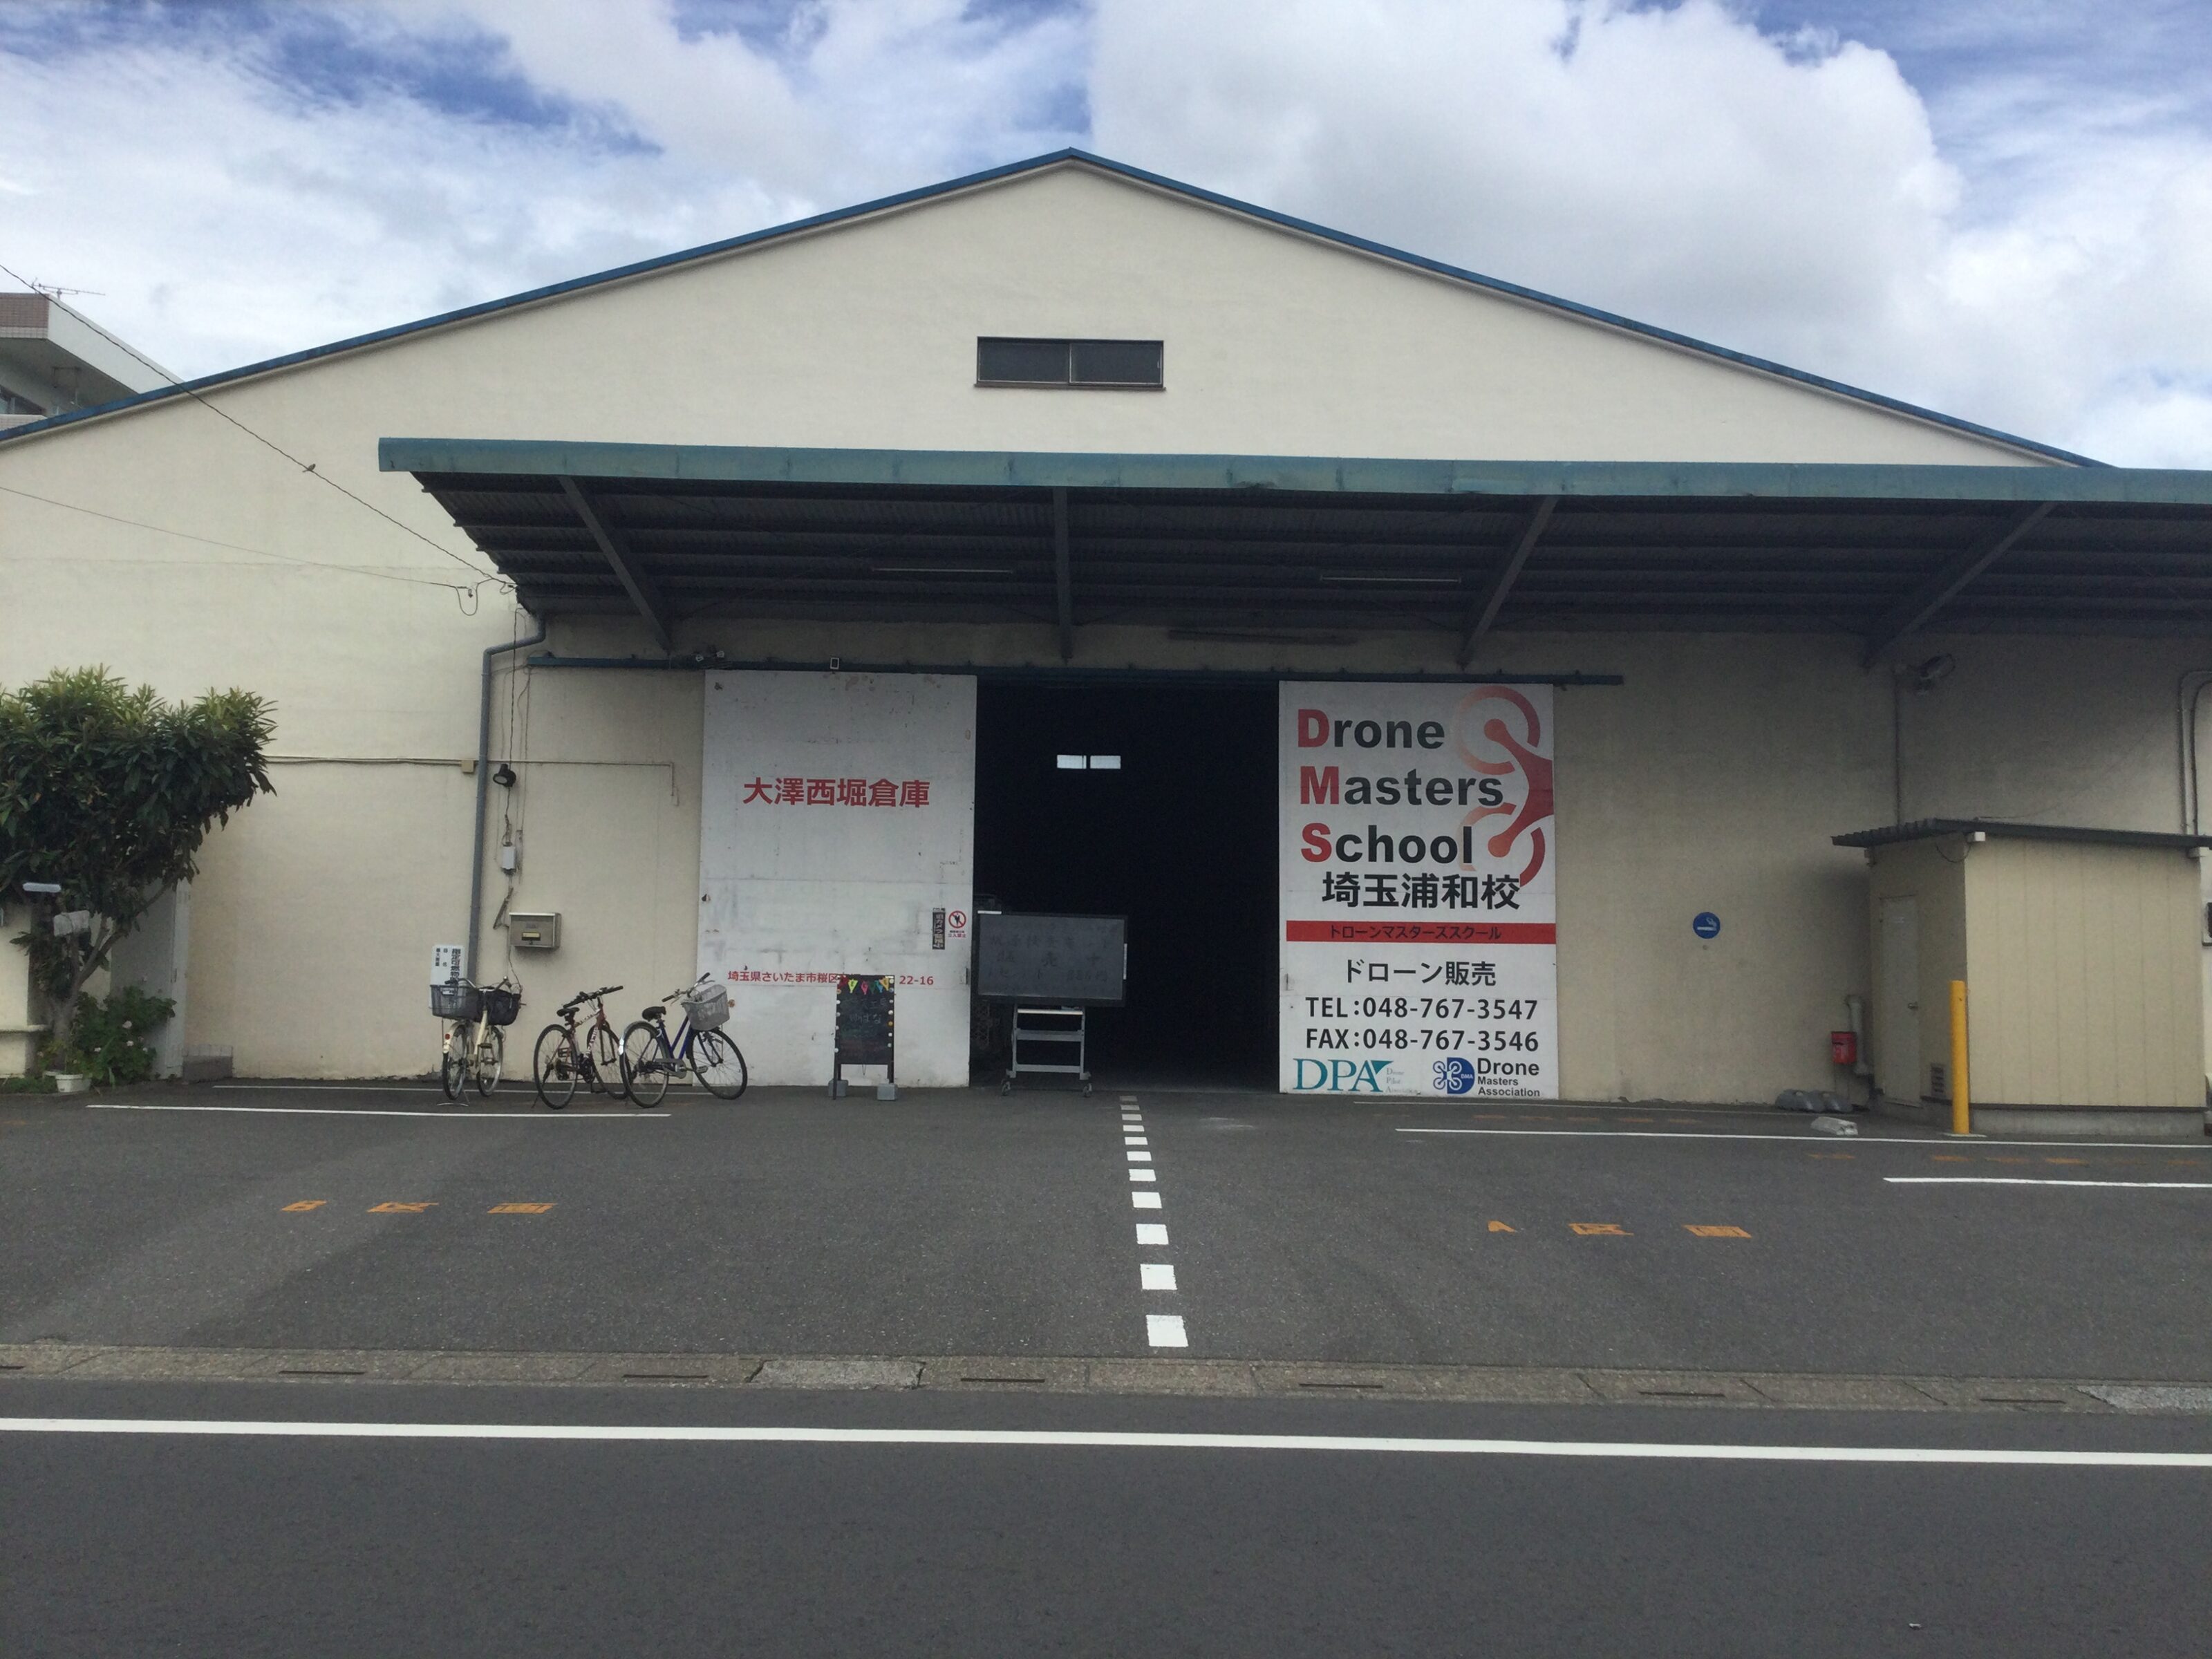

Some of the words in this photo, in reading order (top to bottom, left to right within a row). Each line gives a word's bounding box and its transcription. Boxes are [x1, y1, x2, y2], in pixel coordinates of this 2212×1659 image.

[1297, 709, 1445, 749] Drone
[743, 777, 930, 808] 大澤西堀倉庫
[1300, 765, 1504, 806] Masters
[1300, 822, 1474, 864] School
[1322, 871, 1520, 910] 埼玉浦和校
[1347, 959, 1497, 986] ドローン販売
[1292, 1058, 1392, 1093] DPA
[1477, 1058, 1540, 1076] Drone
[1477, 1076, 1519, 1085] Masters
[1478, 1087, 1541, 1097] Association
